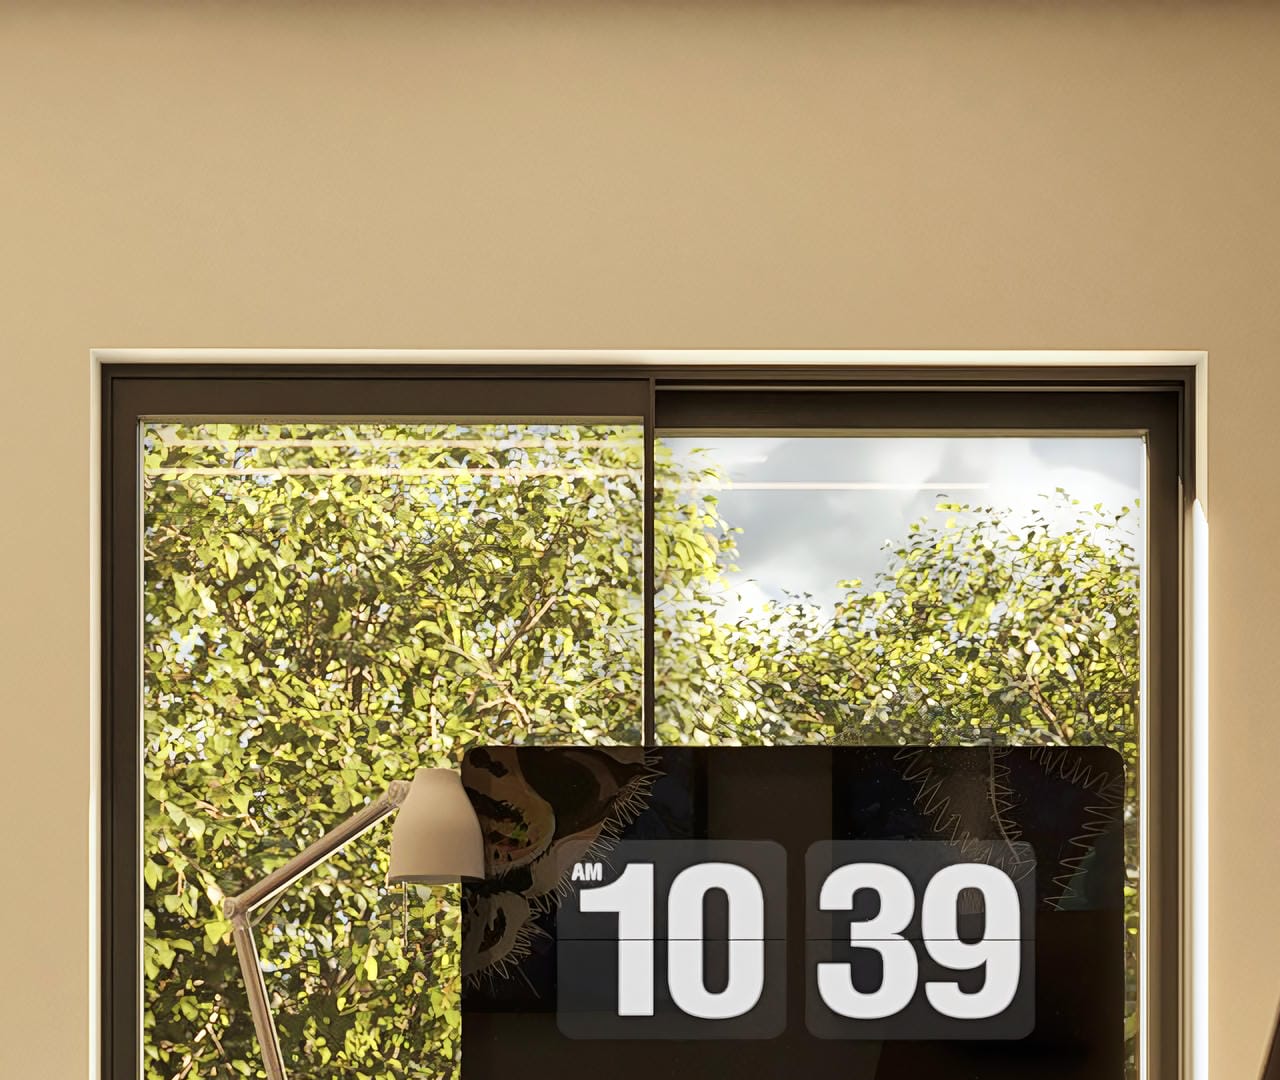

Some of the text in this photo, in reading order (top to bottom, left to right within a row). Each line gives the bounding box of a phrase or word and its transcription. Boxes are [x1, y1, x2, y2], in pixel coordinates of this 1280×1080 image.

[570, 861, 603, 882] AM
[579, 861, 1021, 1020] 10 39
